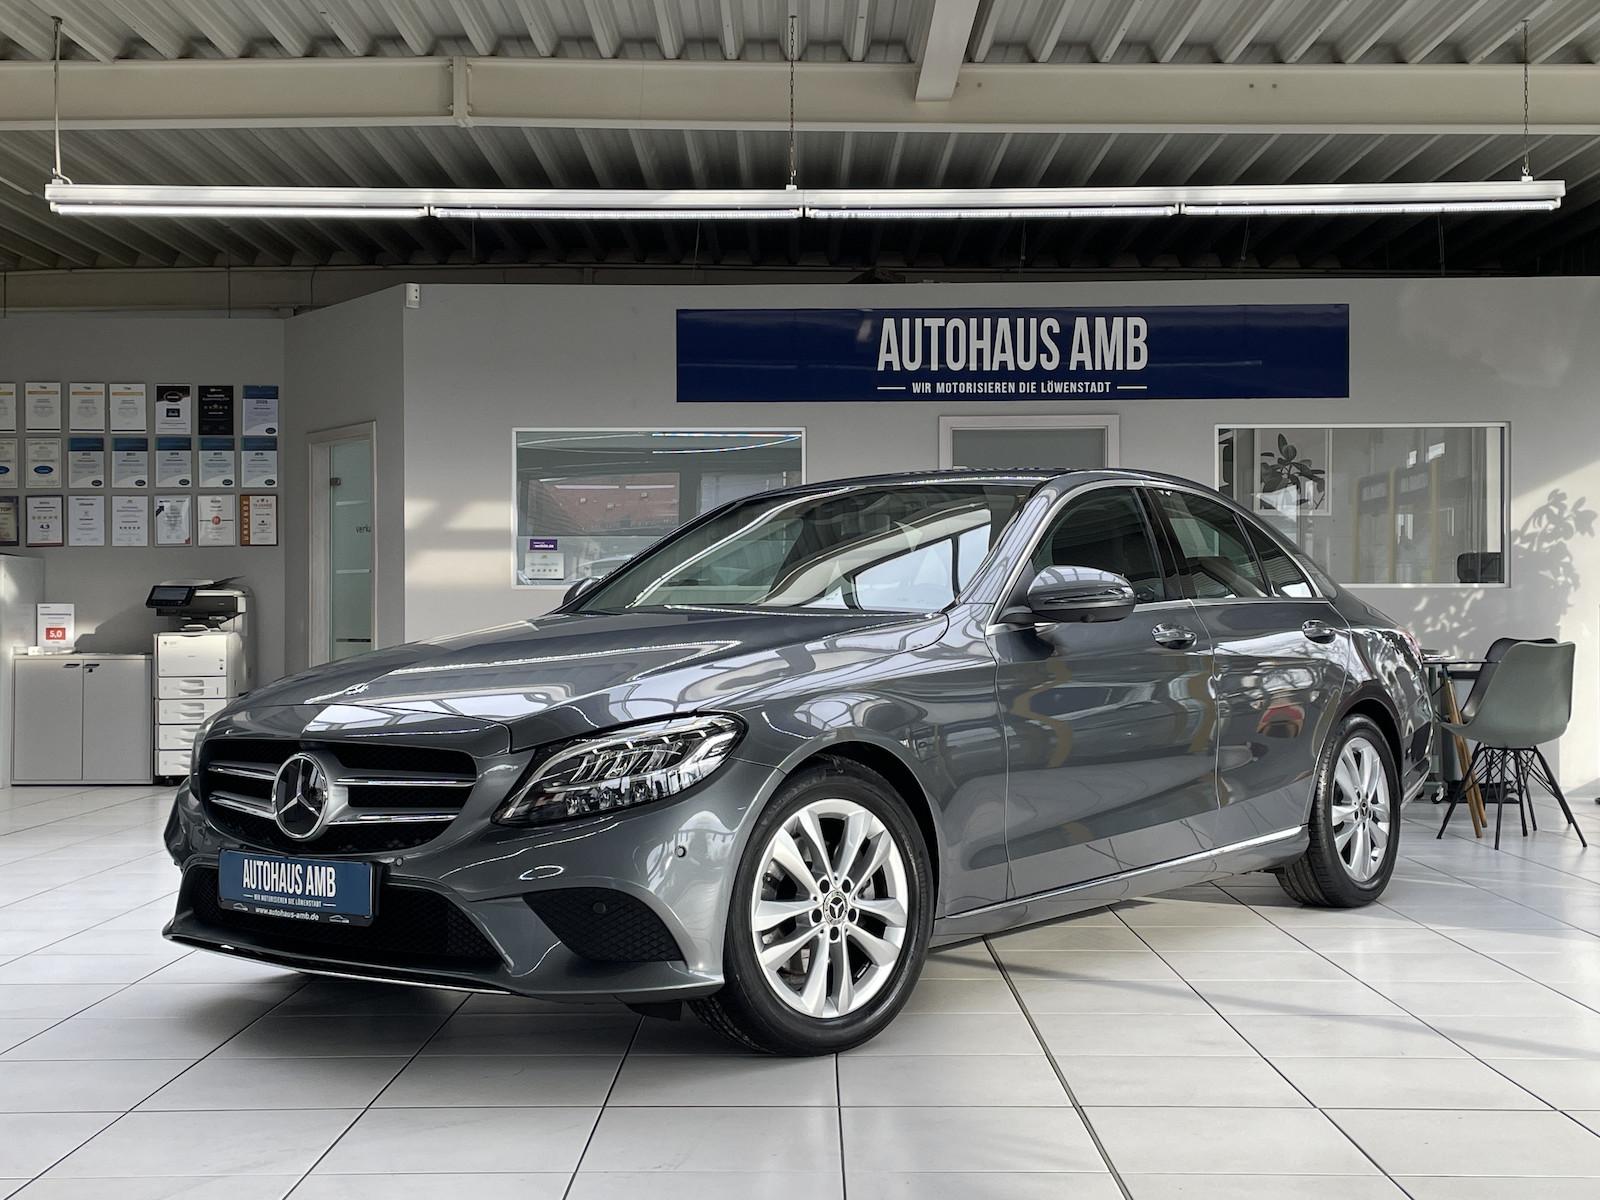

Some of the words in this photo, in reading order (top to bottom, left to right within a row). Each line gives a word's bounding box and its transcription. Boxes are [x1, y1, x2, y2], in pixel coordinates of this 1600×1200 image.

[877, 317, 1060, 372] AUTOHAUS
[1069, 316, 1149, 371] AMB
[912, 382, 932, 393] WIR
[936, 382, 1016, 394] MOTORISIEREN
[1019, 381, 1037, 393] DIE
[1041, 380, 1111, 393] LÖWENSTADT
[243, 859, 303, 894] AUTOHAUS
[306, 866, 336, 897] AMB
[255, 907, 319, 921] www.autohaus-amb.de
